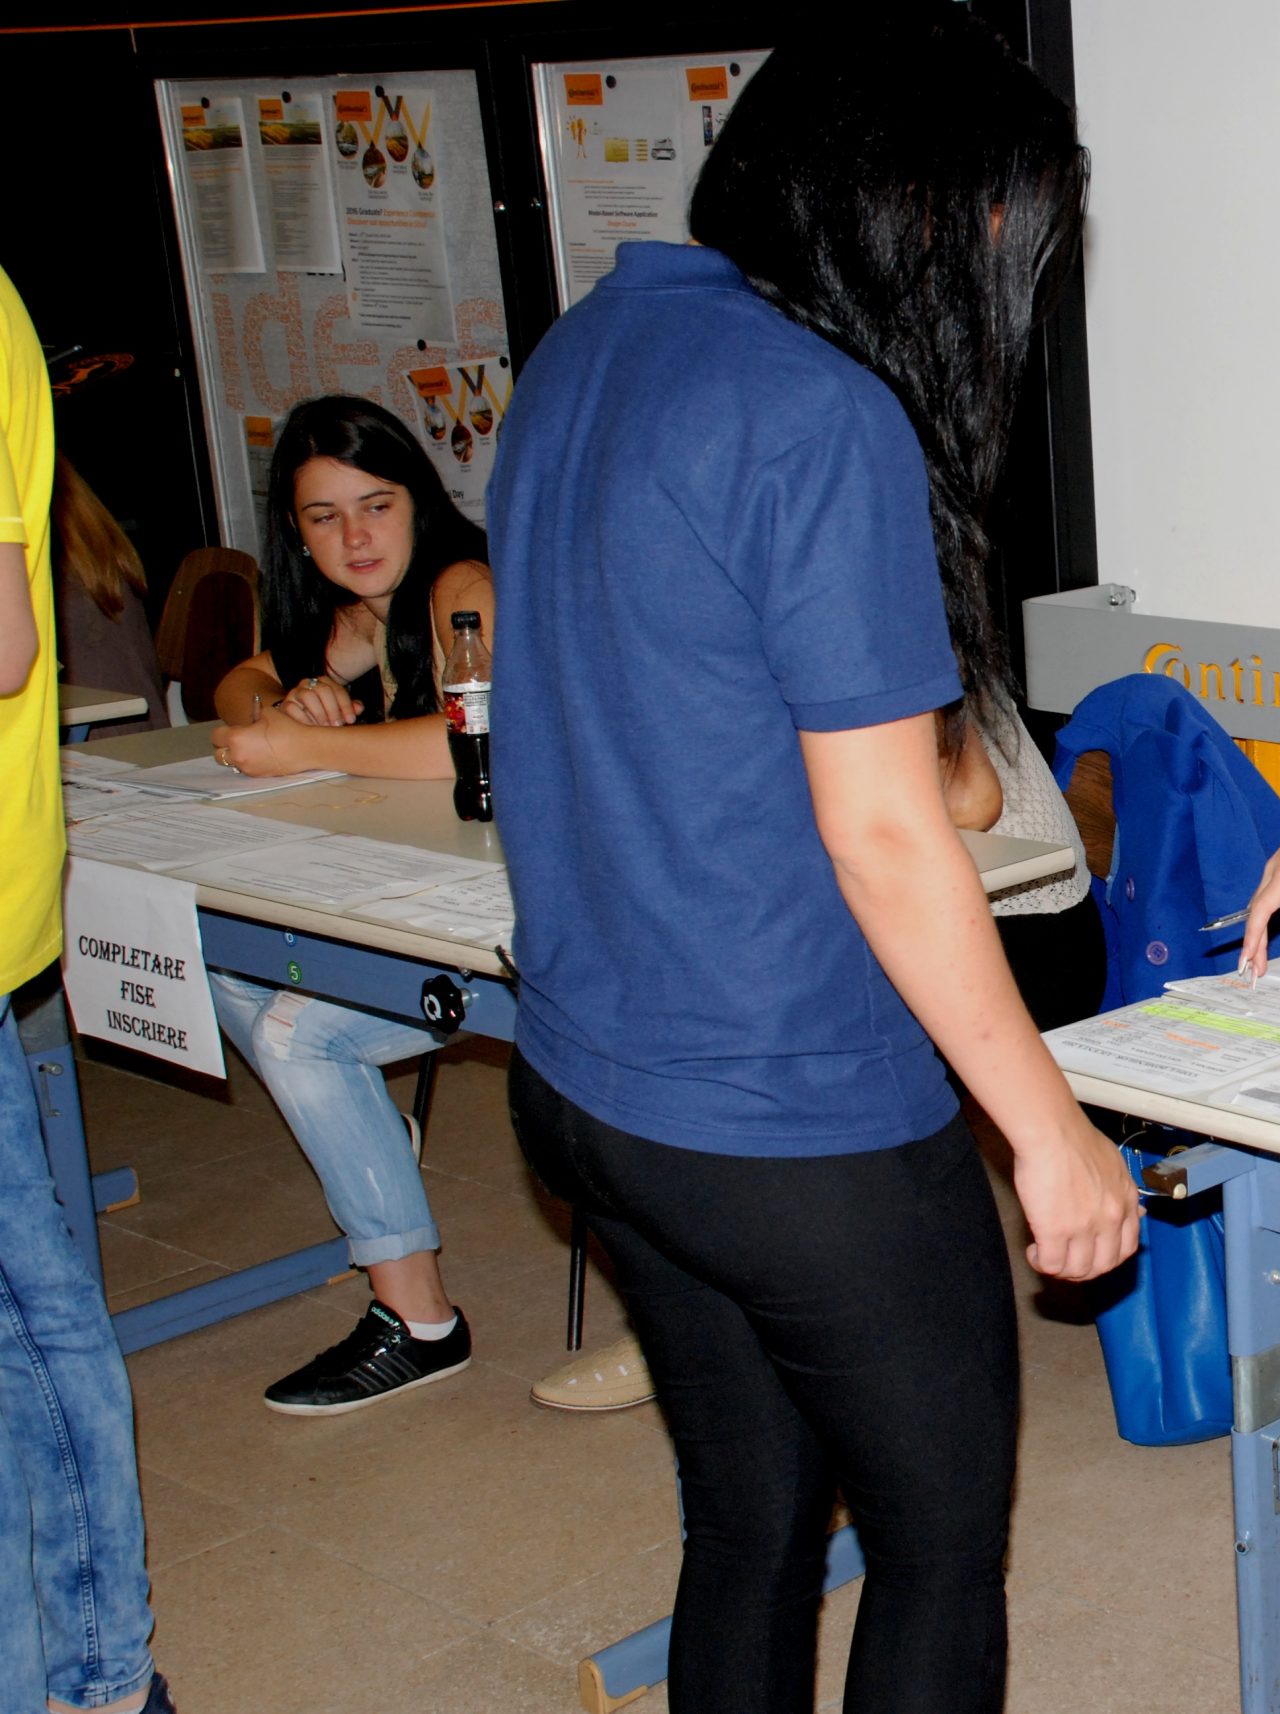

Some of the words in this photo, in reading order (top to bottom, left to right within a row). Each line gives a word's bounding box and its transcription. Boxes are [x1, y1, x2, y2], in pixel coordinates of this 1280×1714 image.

[78, 935, 186, 981] COMPLETARE
[290, 965, 299, 981] 5
[120, 980, 156, 1008] FISE
[106, 1009, 188, 1051] INSCRIERE
